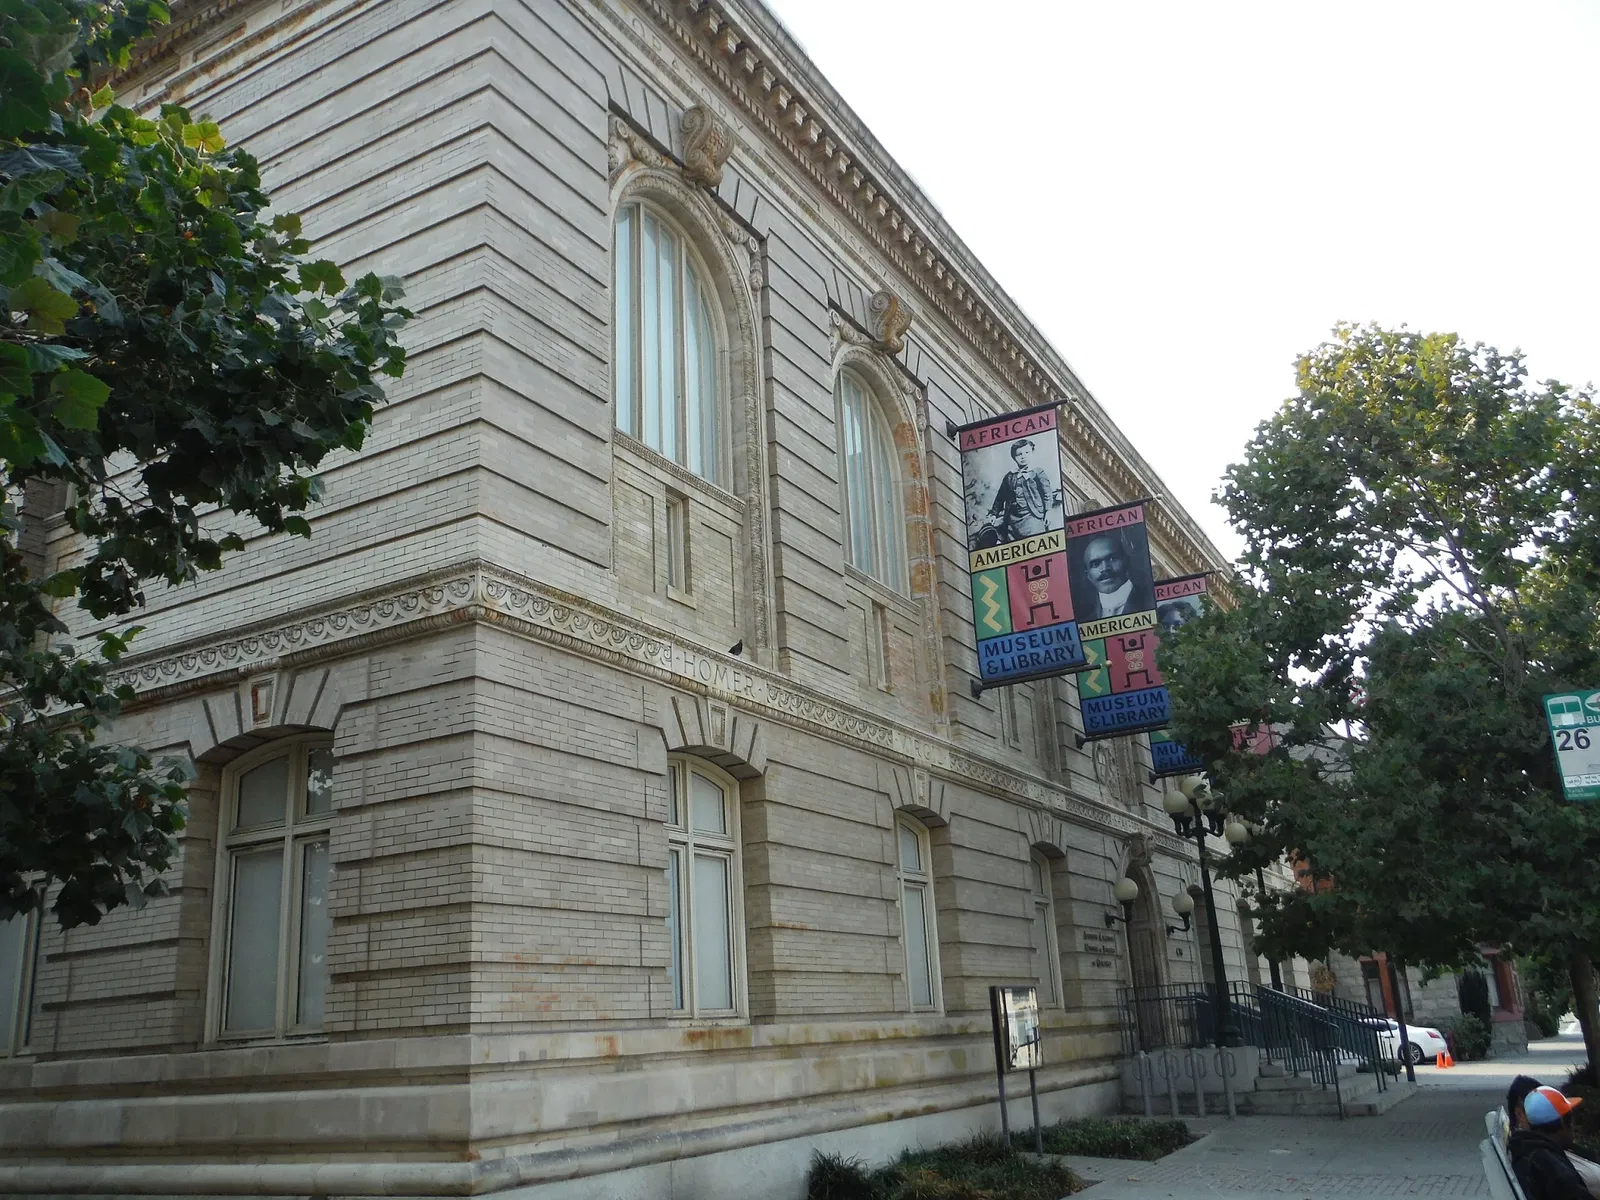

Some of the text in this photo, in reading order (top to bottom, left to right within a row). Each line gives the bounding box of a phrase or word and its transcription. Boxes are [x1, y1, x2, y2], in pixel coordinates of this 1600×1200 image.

[965, 413, 1052, 447] AFRICAN
[1066, 509, 1139, 537] AFRICAN
[974, 534, 1060, 568] AMERICAN
[1156, 581, 1201, 598] RICAN
[1079, 613, 1152, 639] AMERICAN
[983, 626, 1074, 659] MUSEUM
[683, 651, 756, 699] HOMER
[1087, 690, 1165, 715] MUSEUM
[1156, 743, 1186, 757] MUS
[1555, 728, 1591, 752] 26
